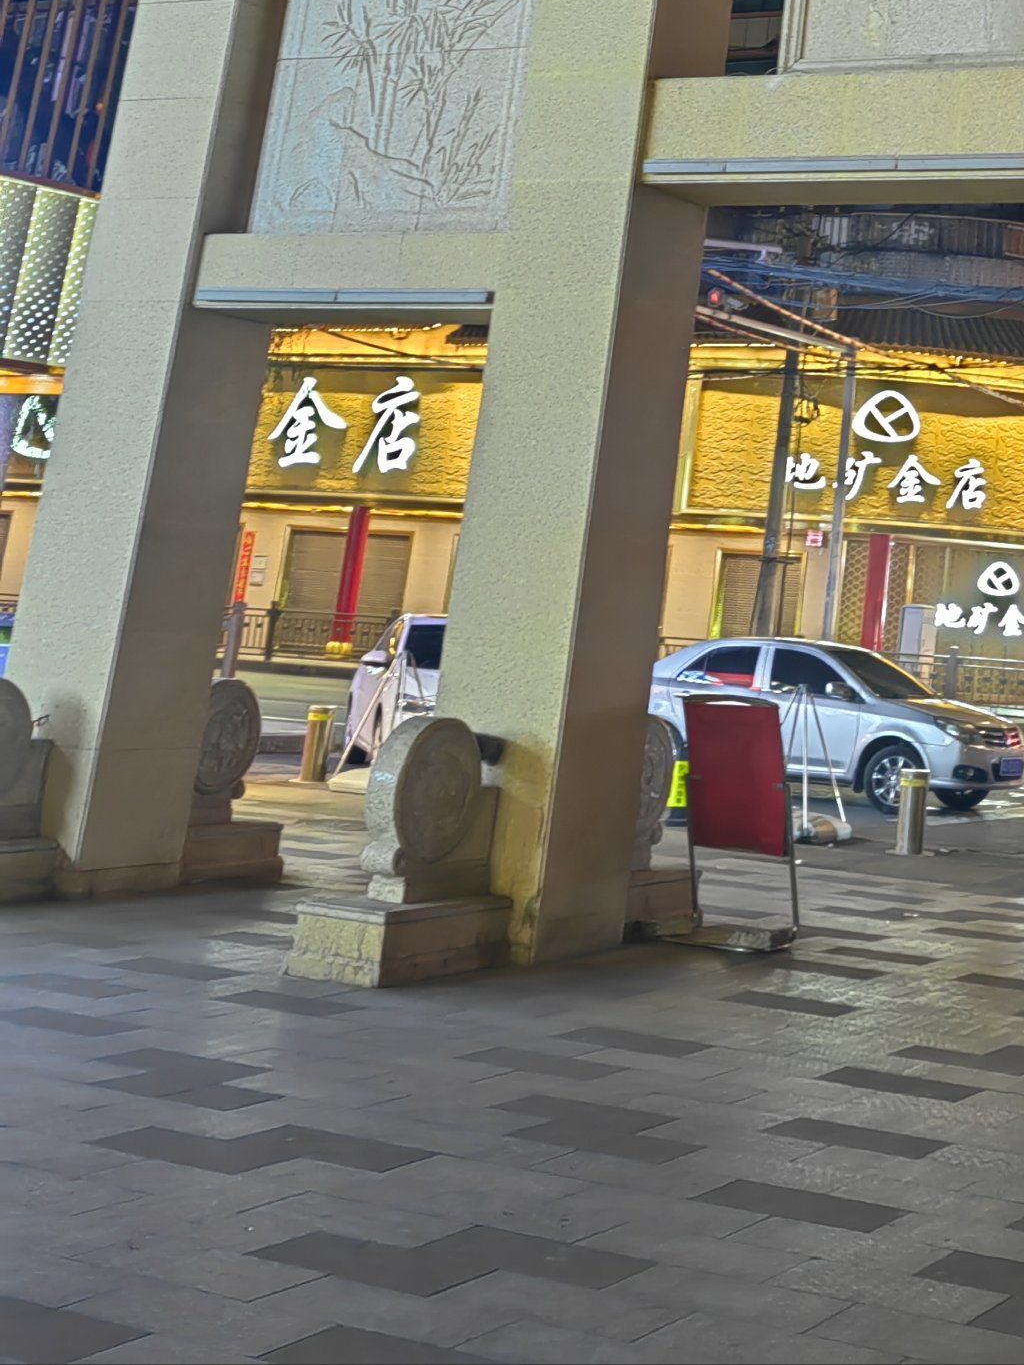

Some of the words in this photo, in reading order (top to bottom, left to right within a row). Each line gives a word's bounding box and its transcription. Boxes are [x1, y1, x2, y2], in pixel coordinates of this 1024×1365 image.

[267, 375, 422, 474] 金店
[784, 450, 988, 510] 地矿金店
